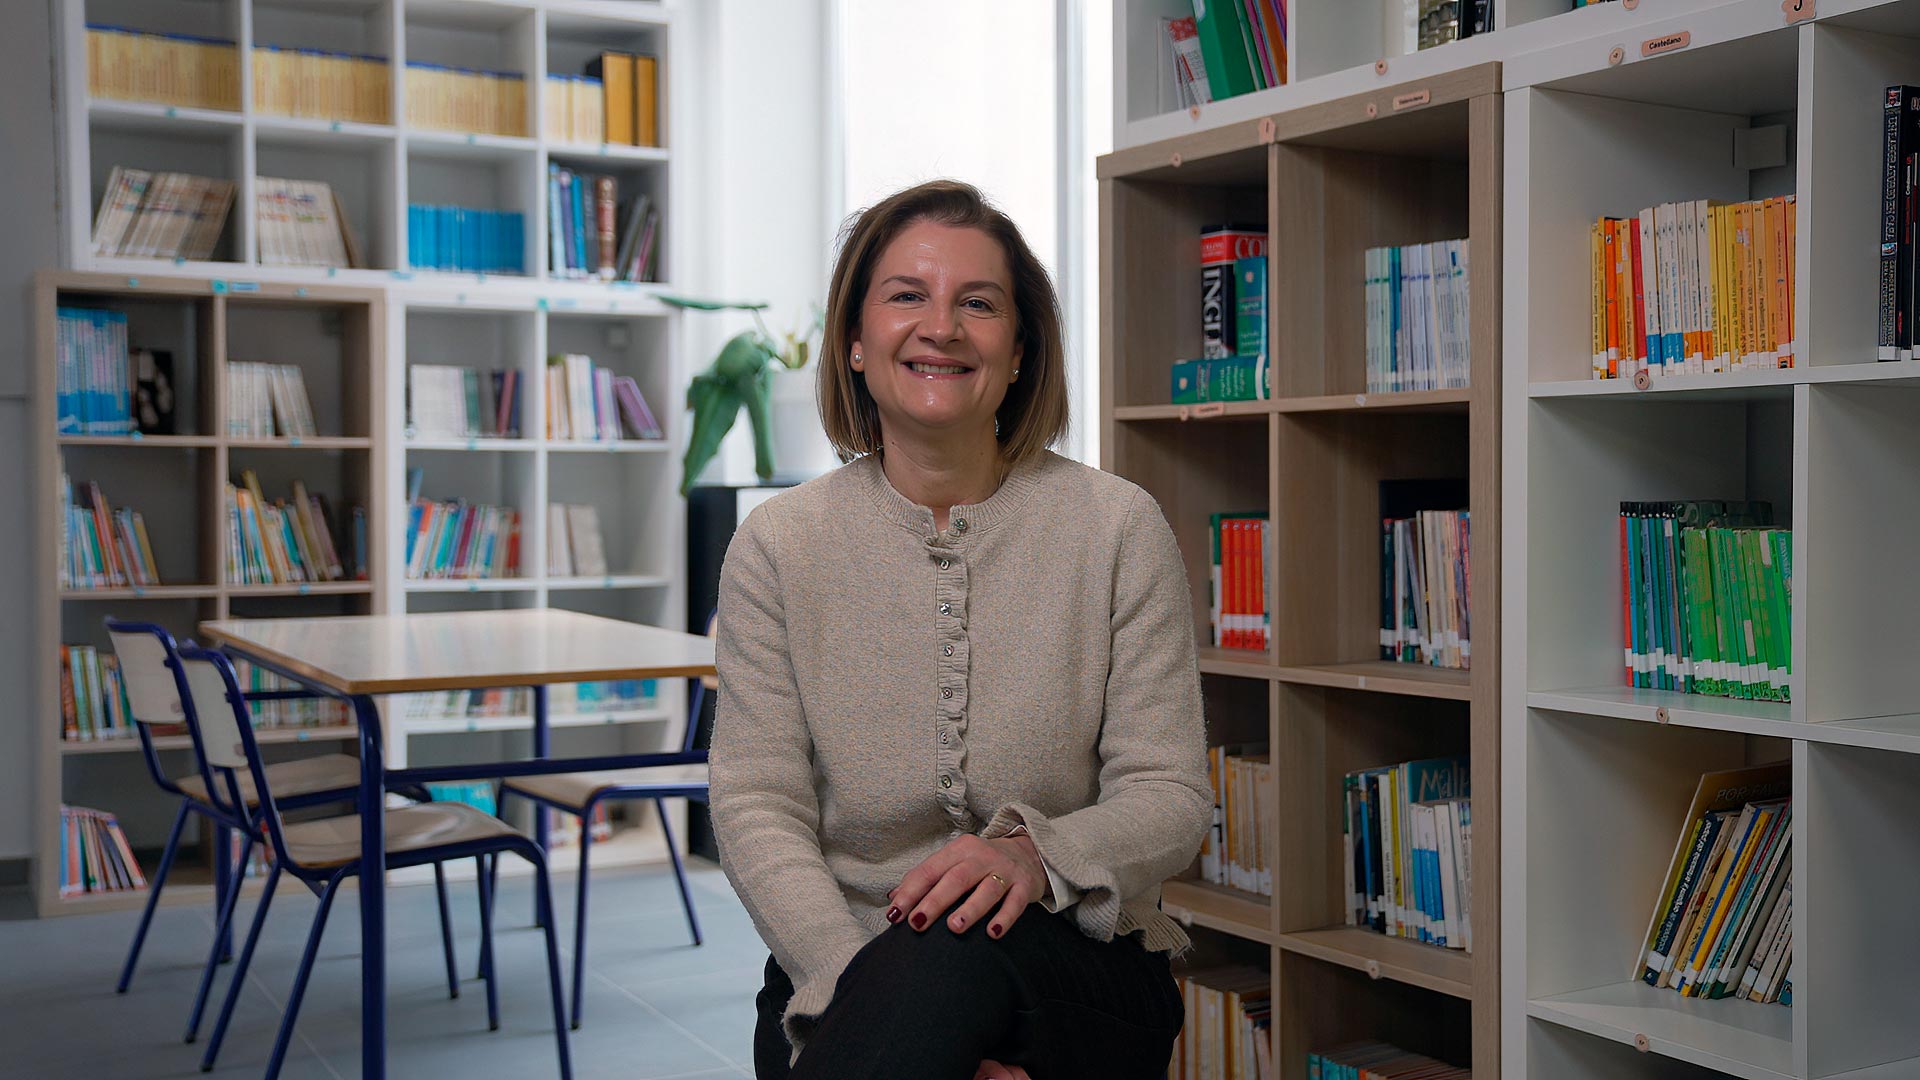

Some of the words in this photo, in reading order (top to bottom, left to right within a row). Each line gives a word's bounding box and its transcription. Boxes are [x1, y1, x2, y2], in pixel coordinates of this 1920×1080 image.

[1649, 36, 1682, 50] Castellano
[1671, 887, 1687, 913] origami
[1699, 820, 1714, 841] papel
